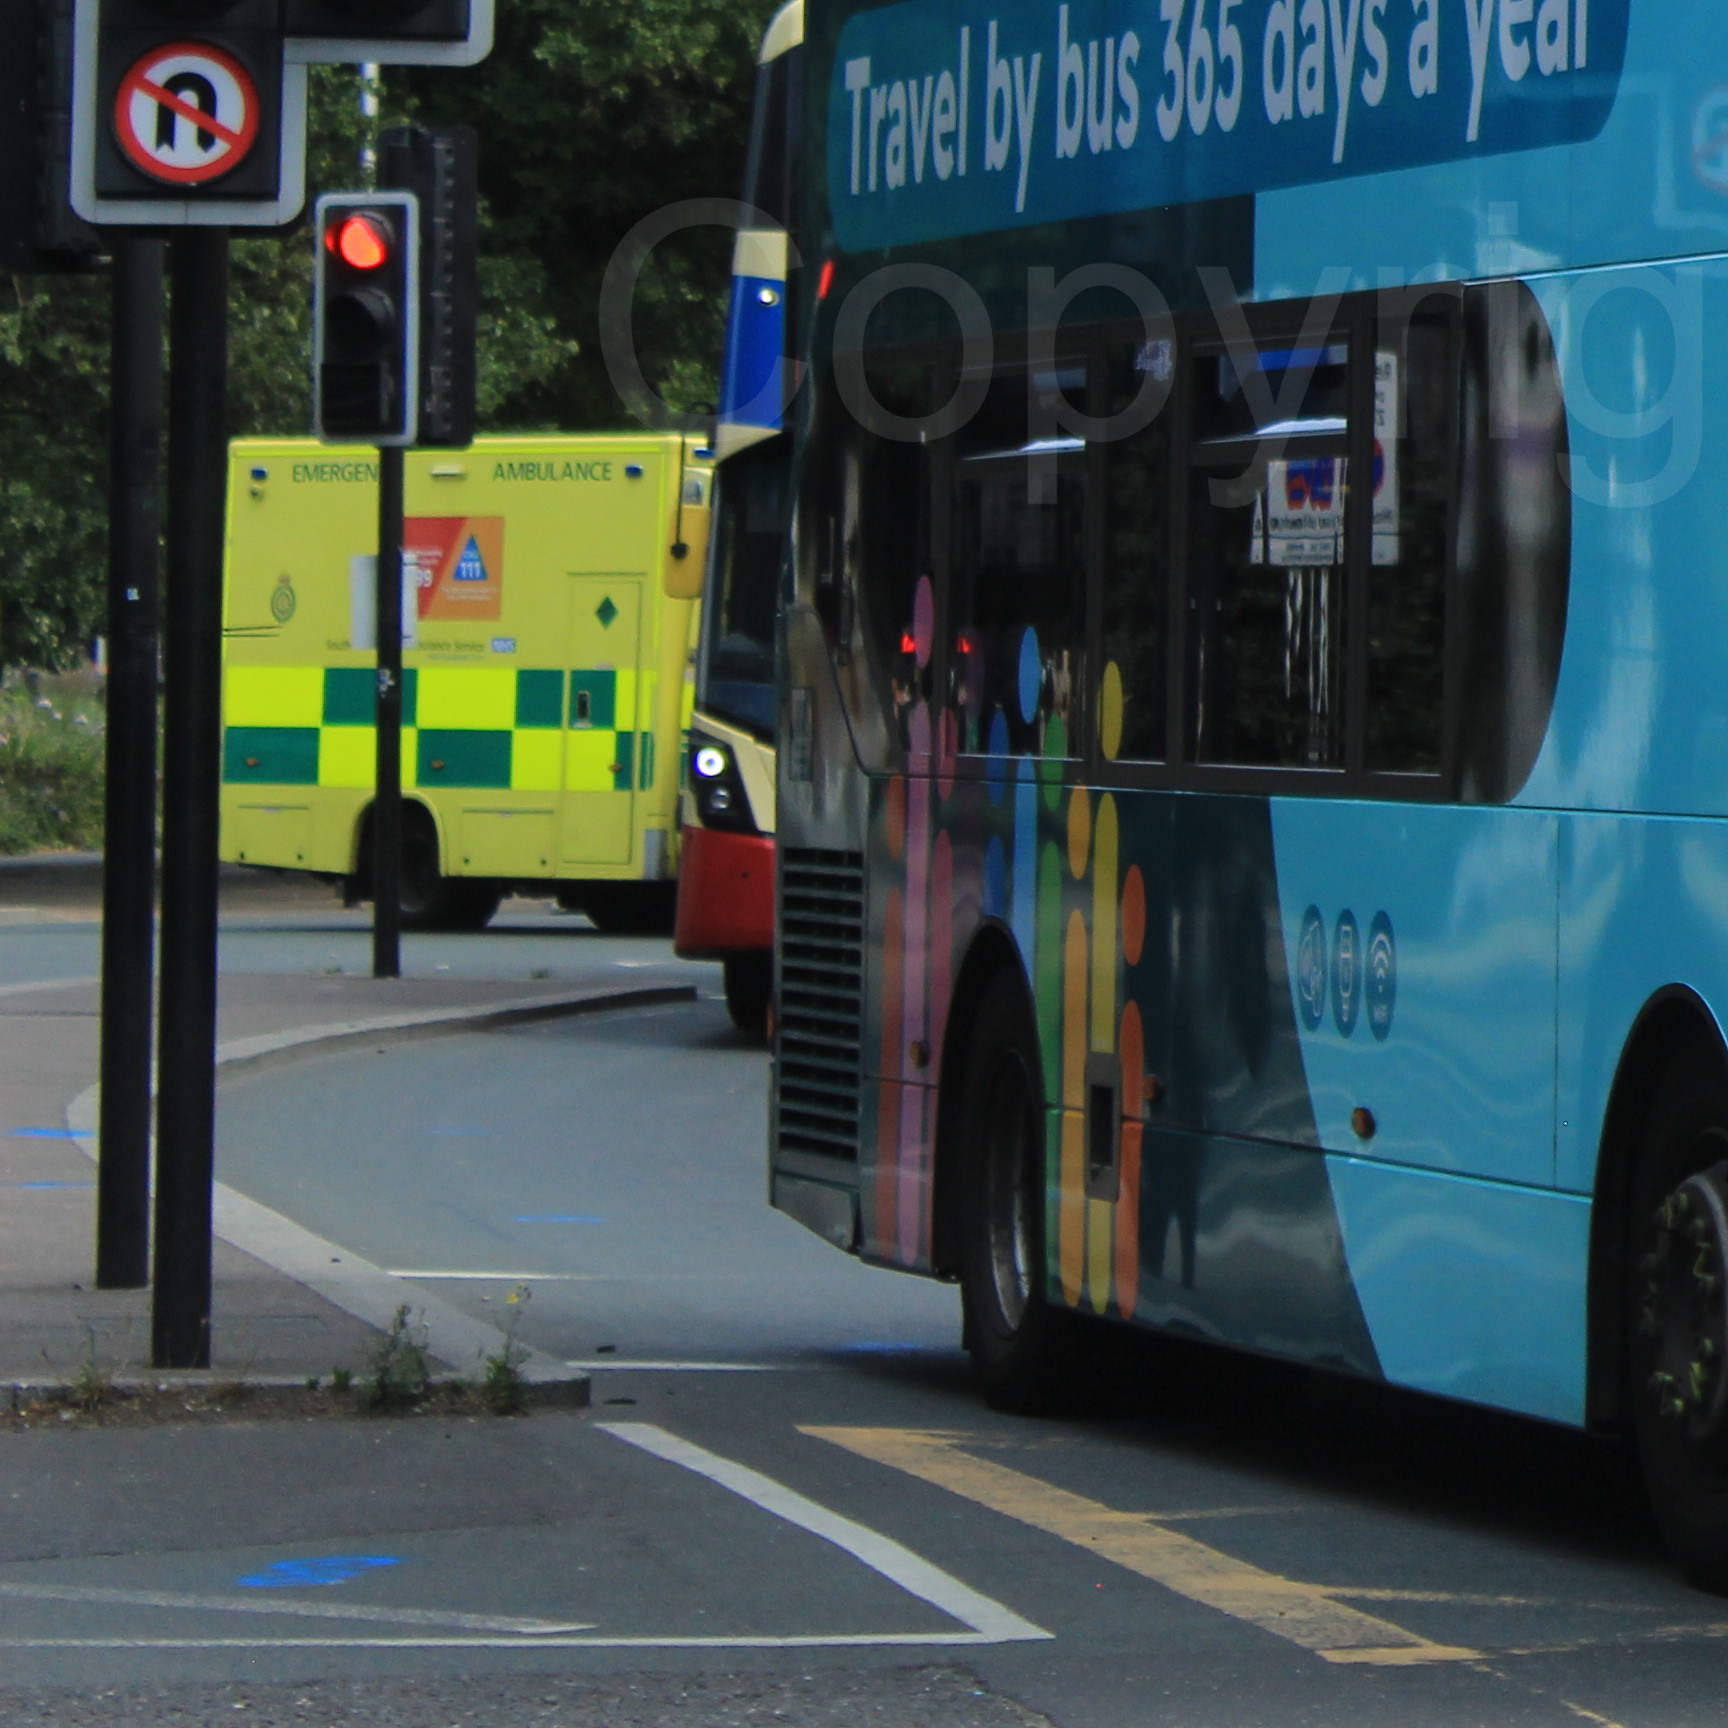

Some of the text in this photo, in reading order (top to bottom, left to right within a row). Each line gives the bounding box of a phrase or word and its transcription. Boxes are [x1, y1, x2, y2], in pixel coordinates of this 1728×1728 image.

[845, 25, 970, 196] Travel
[985, 19, 1042, 213] by
[1056, 3, 1141, 160] bus
[292, 461, 614, 483] EMERGEN AMBULANCE
